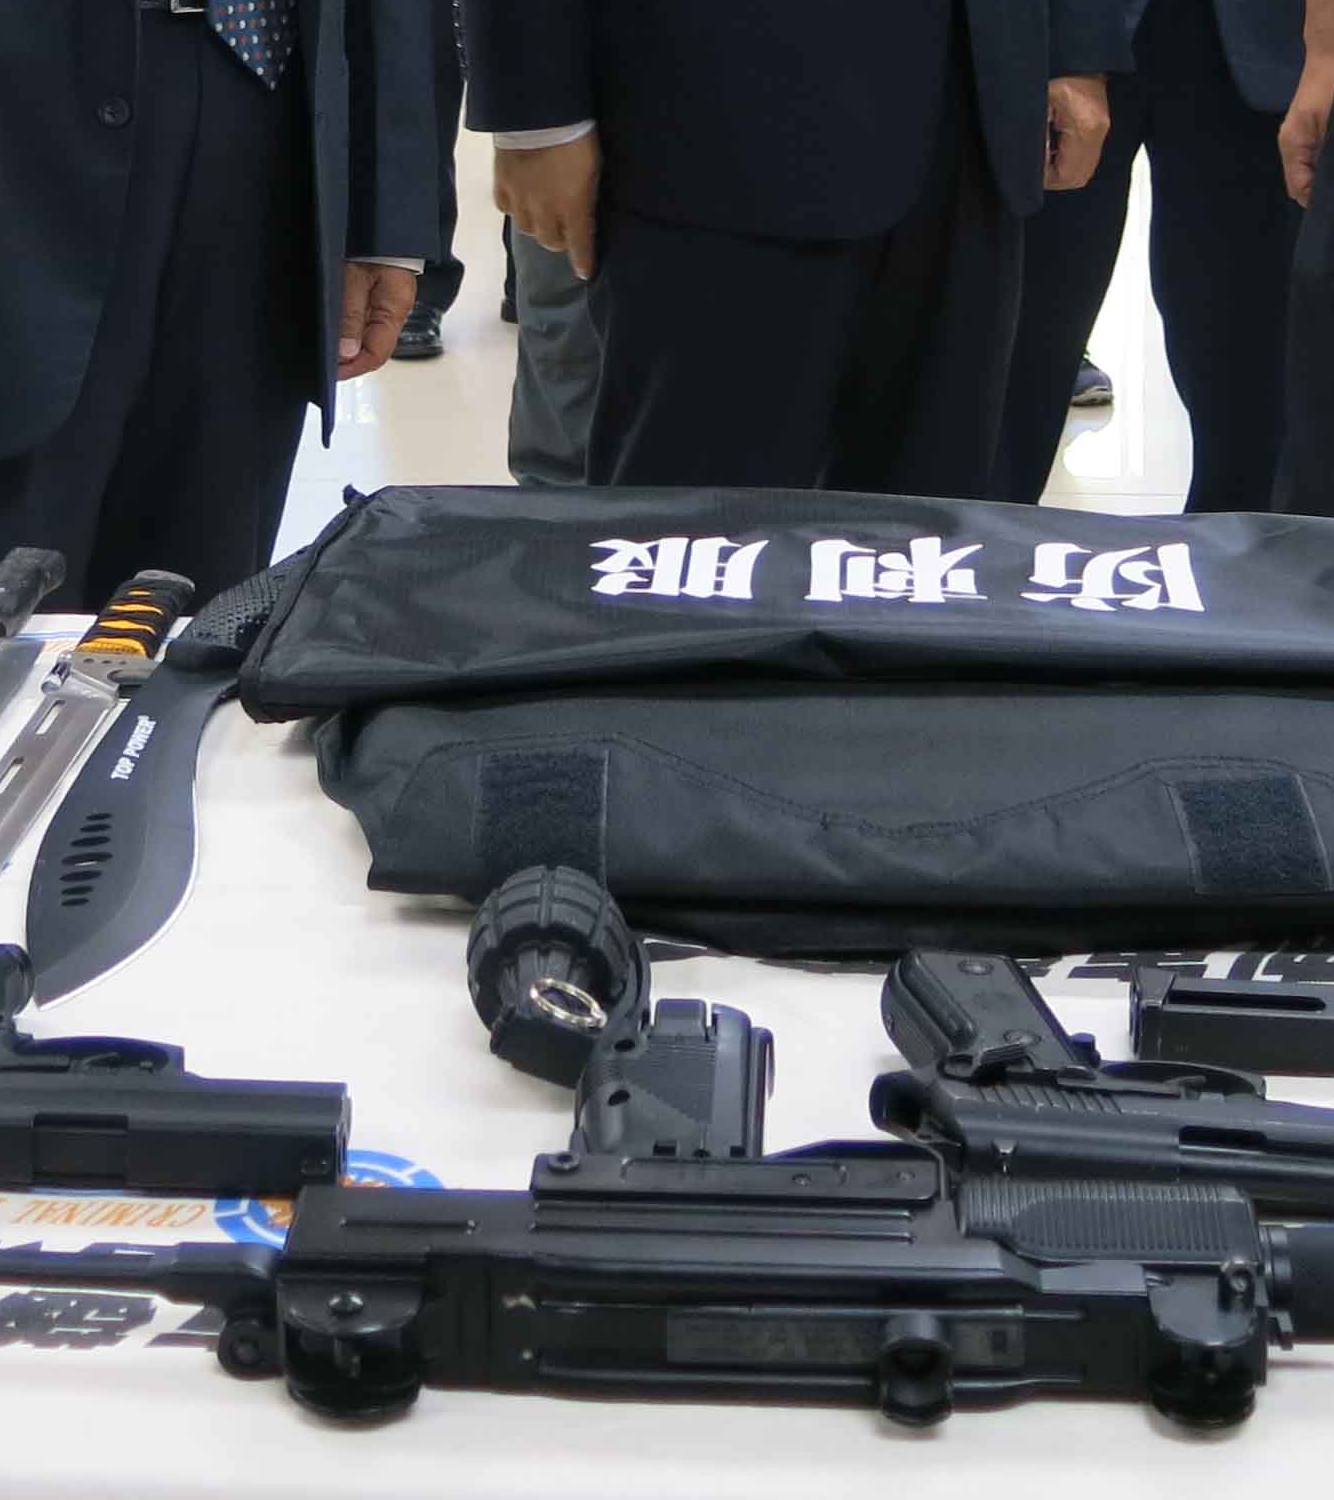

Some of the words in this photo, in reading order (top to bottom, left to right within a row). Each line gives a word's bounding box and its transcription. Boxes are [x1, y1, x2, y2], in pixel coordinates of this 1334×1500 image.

[588, 535, 1207, 614] 防刺服
[122, 714, 157, 759] POWER
[110, 756, 136, 780] TOP
